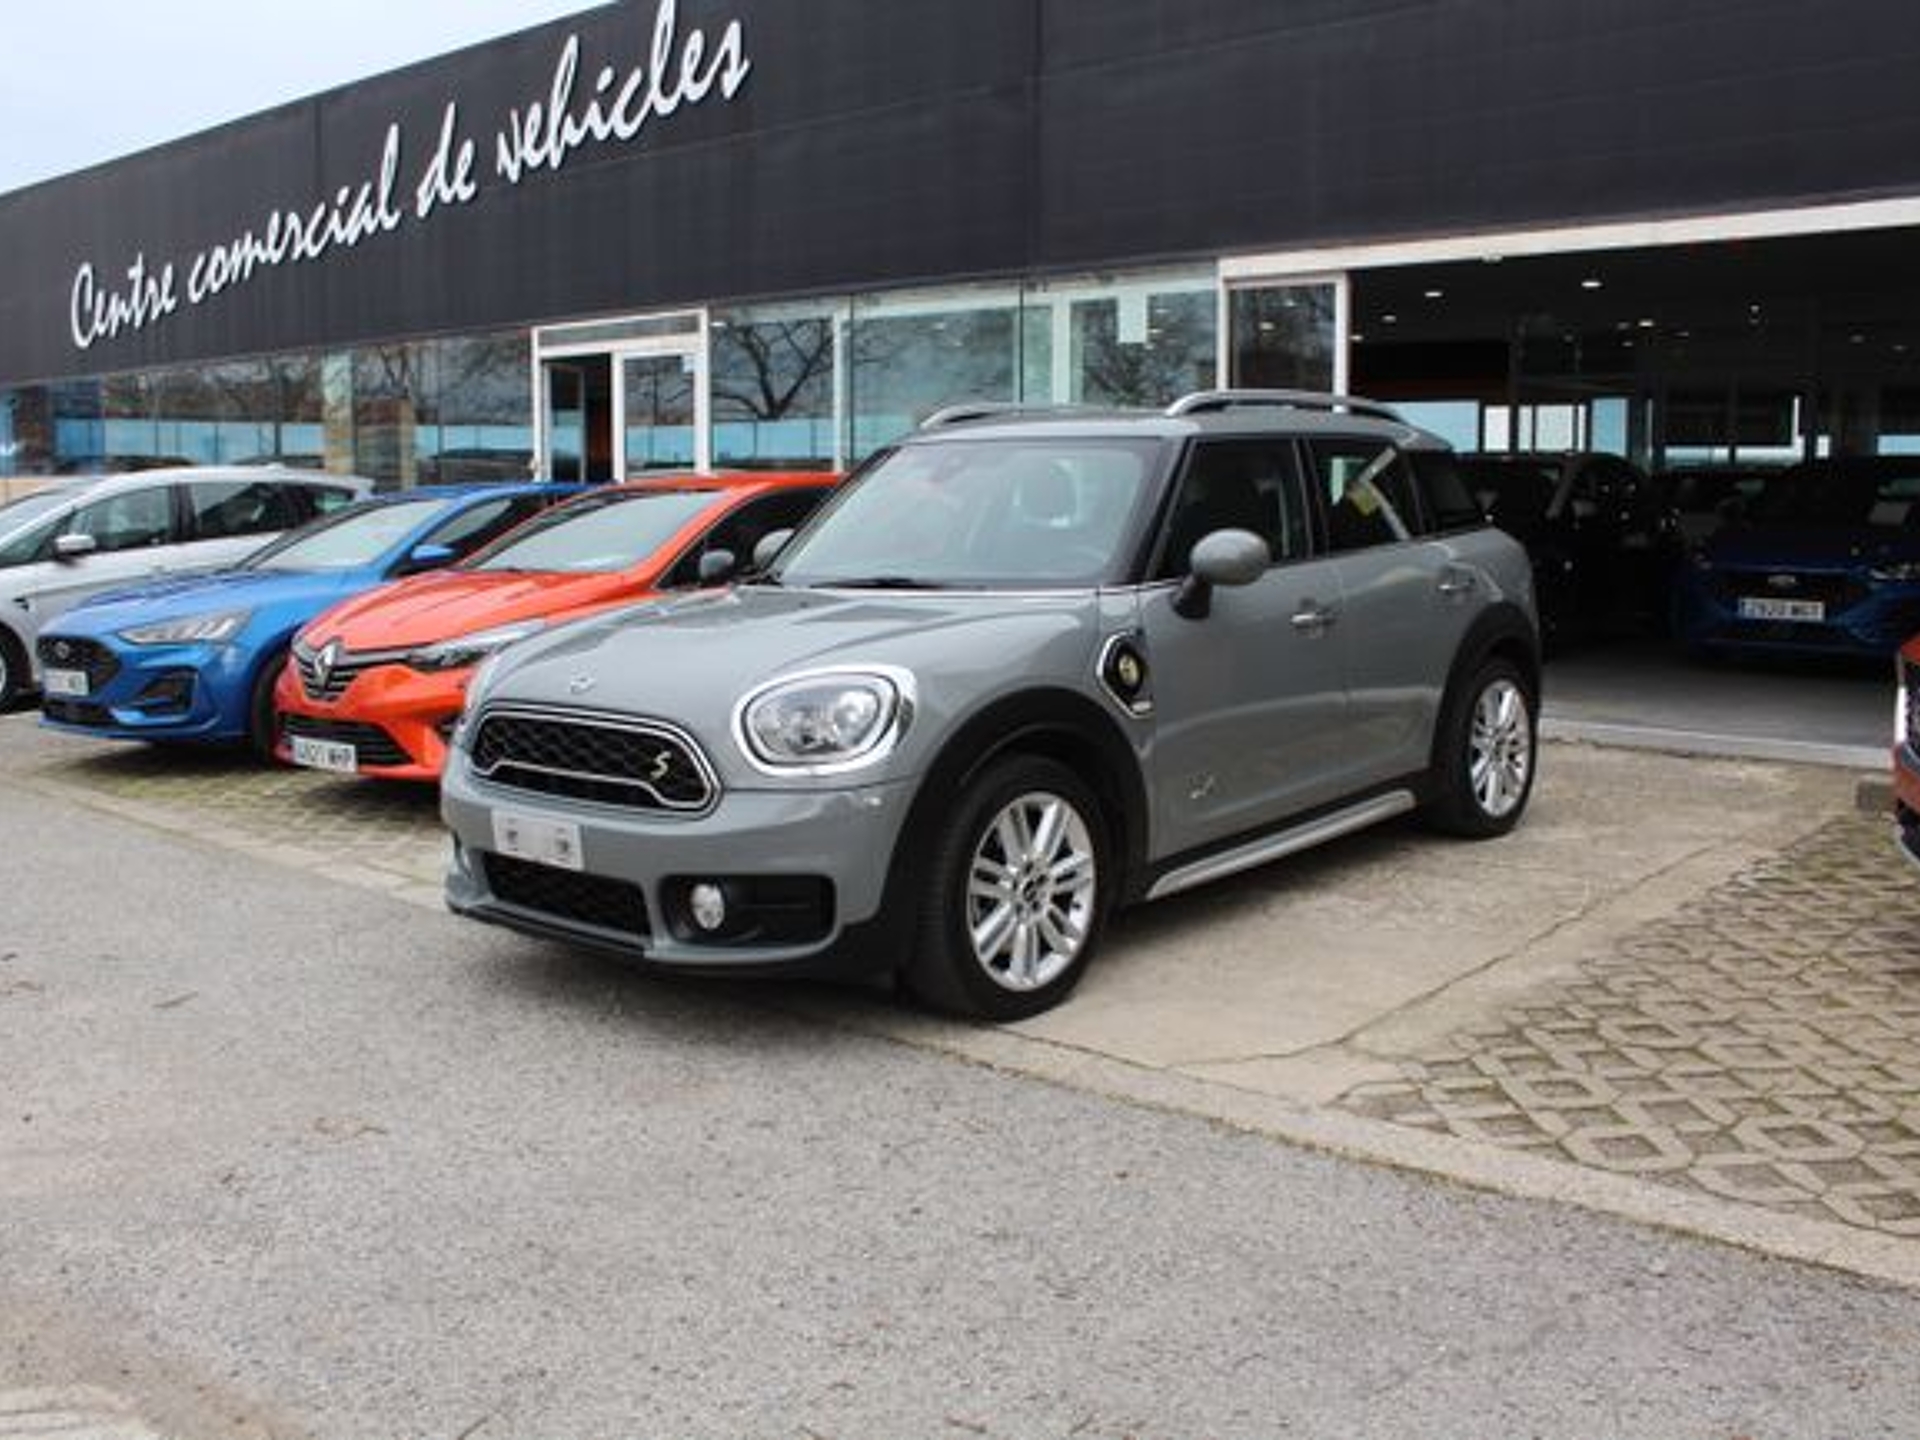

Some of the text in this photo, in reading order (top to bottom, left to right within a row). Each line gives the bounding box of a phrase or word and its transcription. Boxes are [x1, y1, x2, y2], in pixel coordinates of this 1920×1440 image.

[71, 0, 749, 348] Centre comercial de vehicles
[651, 751, 671, 779] S
